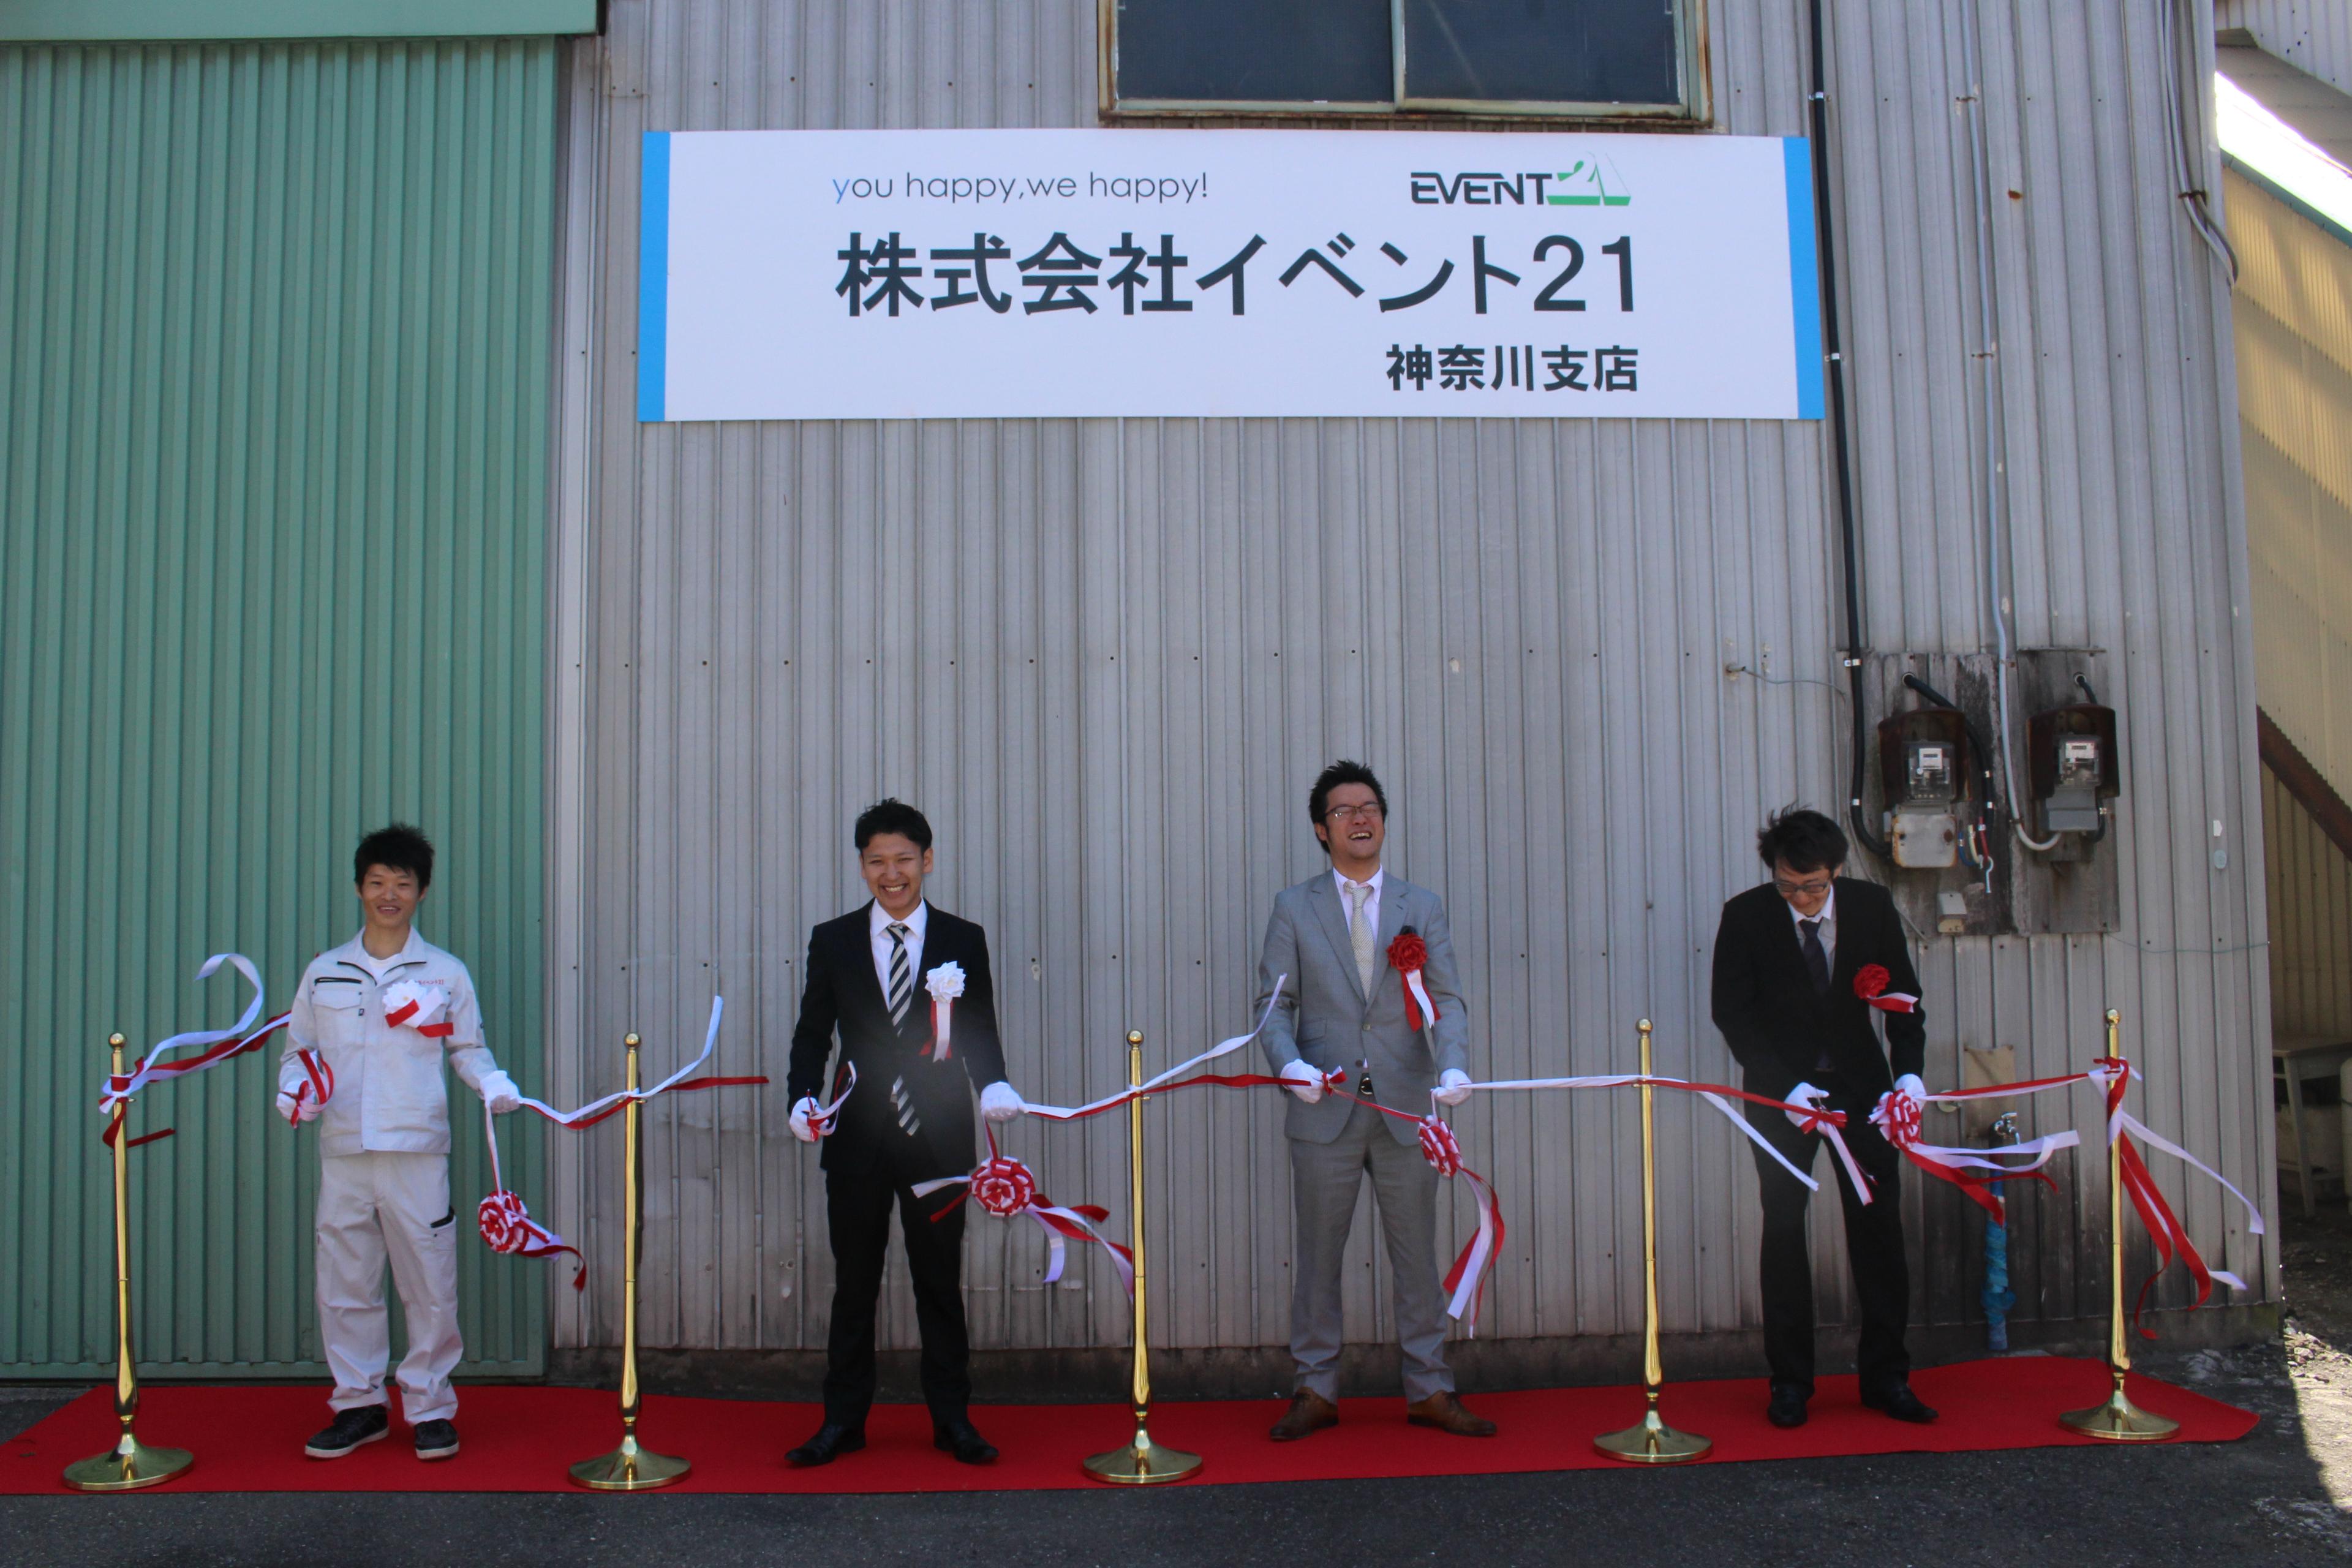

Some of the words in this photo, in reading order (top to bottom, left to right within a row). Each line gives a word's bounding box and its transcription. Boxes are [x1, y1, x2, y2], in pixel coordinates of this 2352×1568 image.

[832, 178, 894, 205] you
[1090, 171, 1207, 205] happy!
[835, 232, 1634, 317] 株式会社イベント21
[1386, 344, 1638, 391] 神奈川支店
